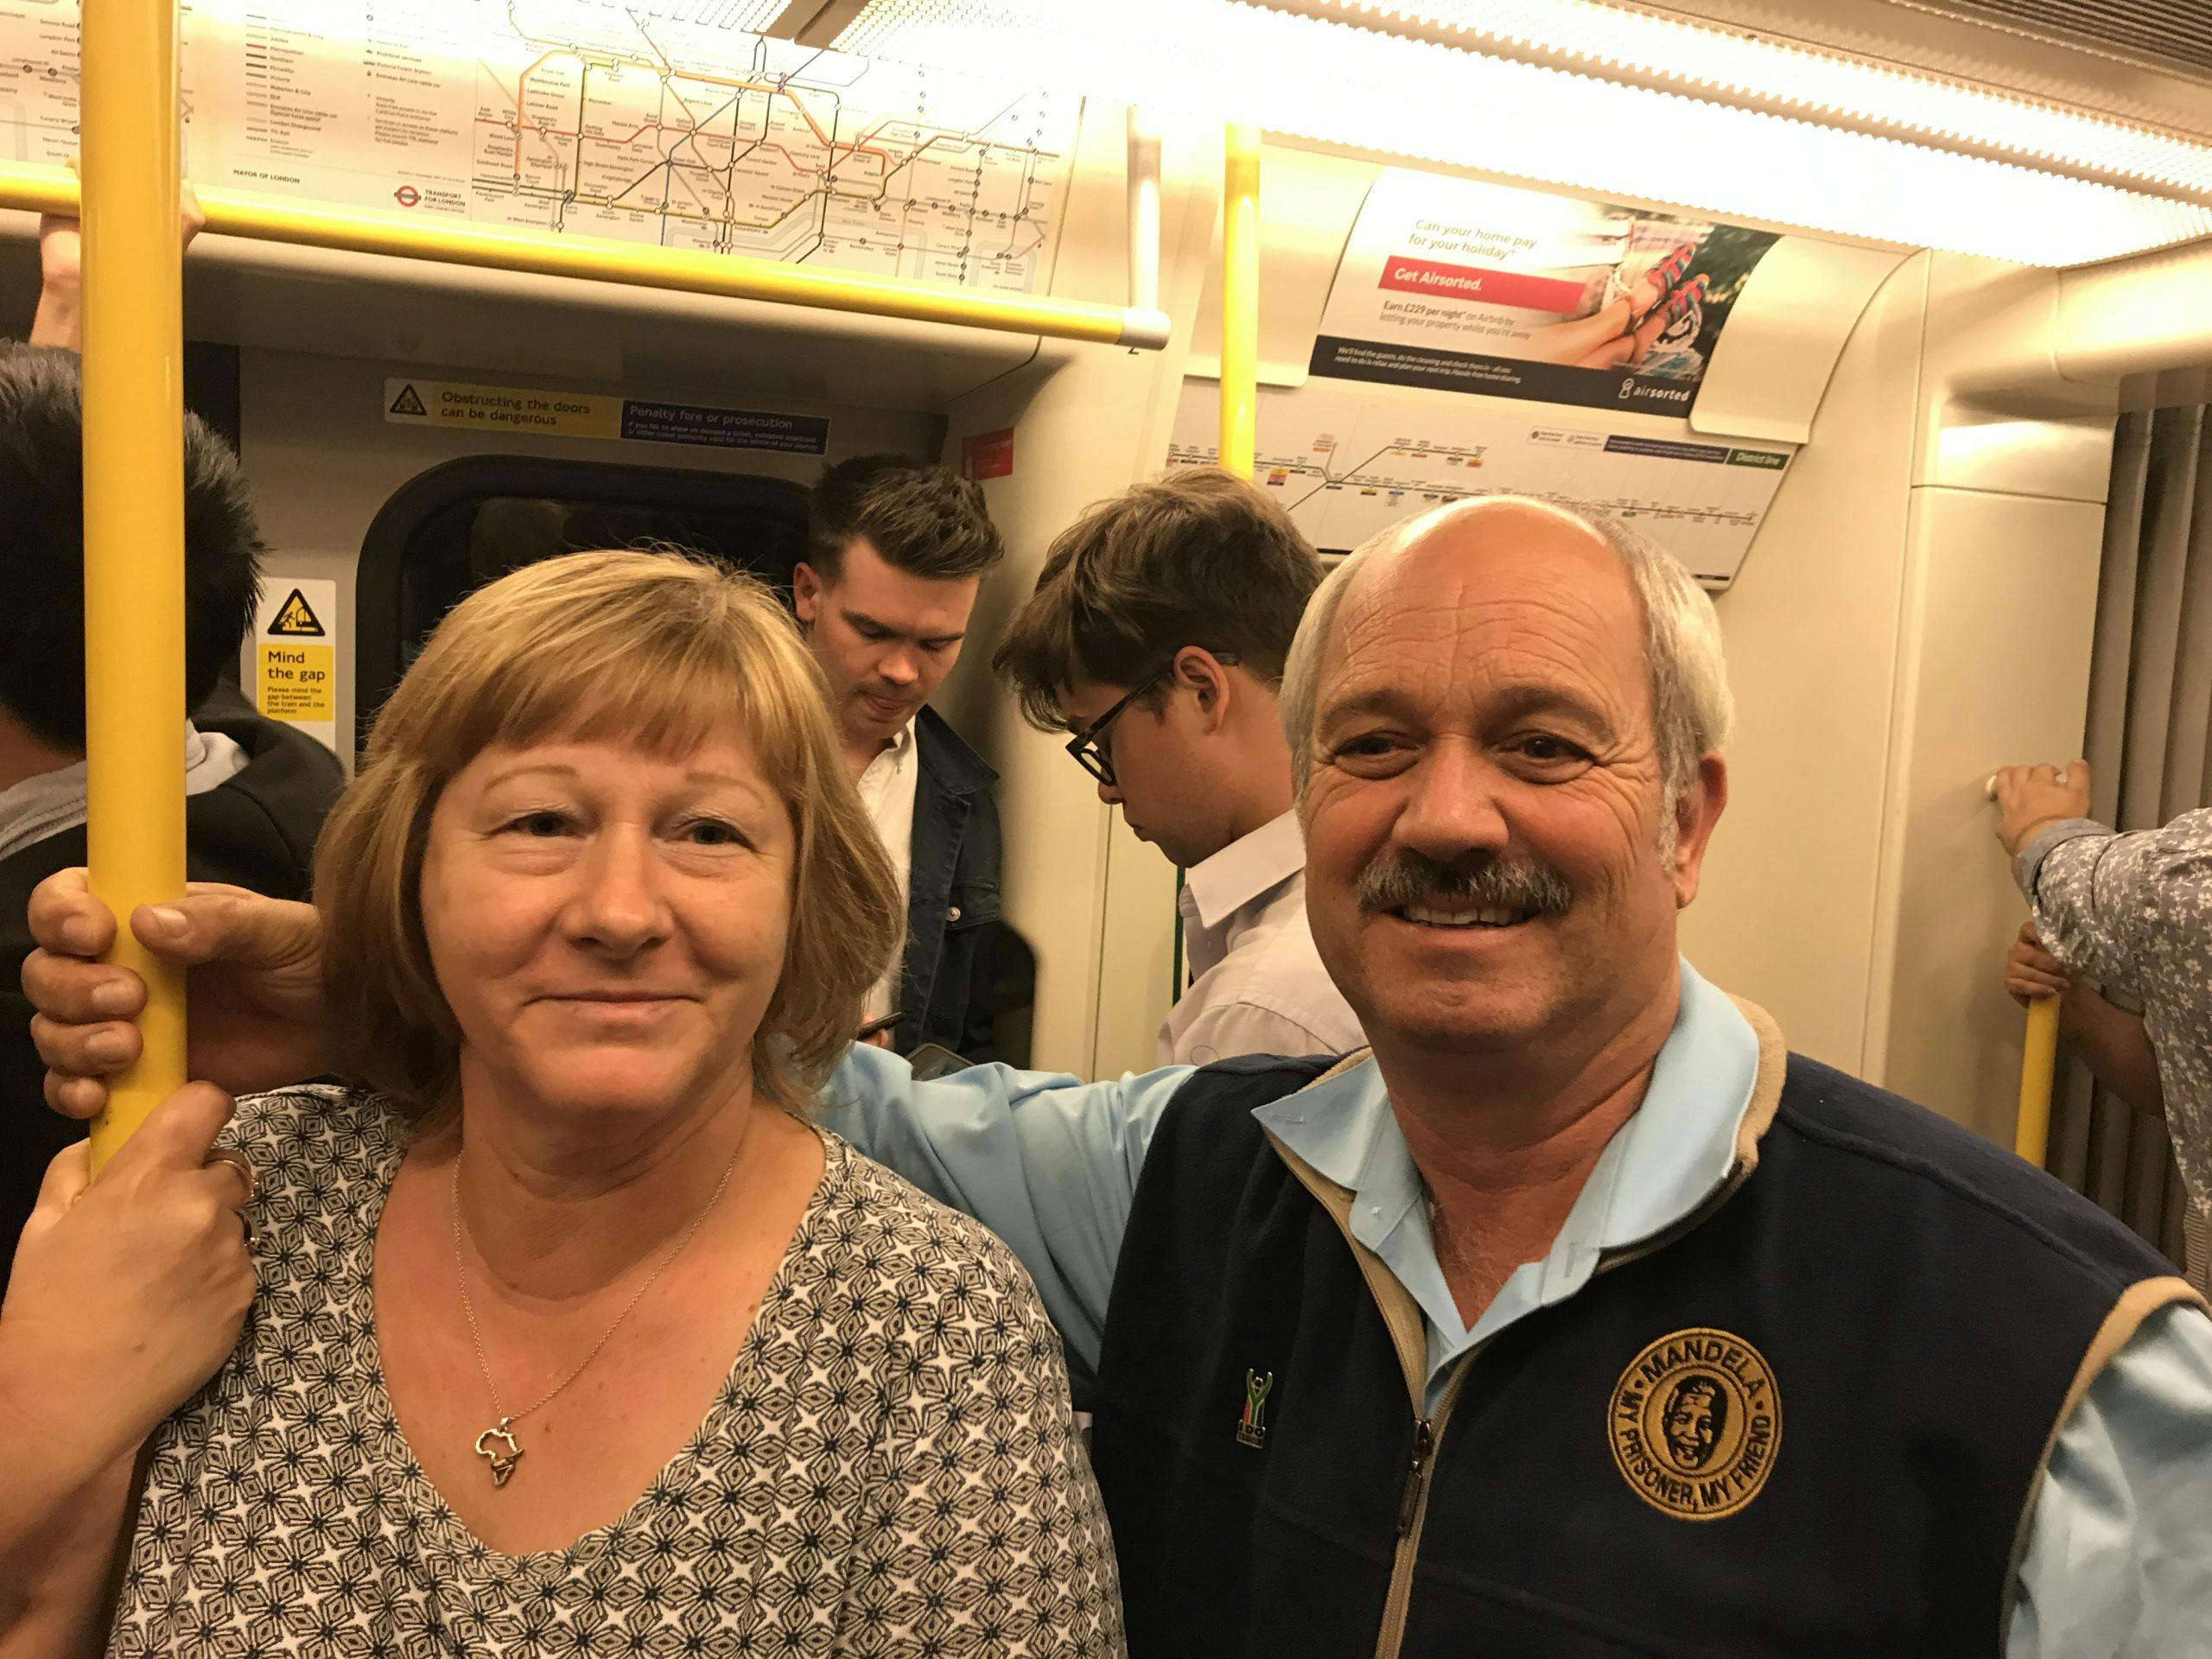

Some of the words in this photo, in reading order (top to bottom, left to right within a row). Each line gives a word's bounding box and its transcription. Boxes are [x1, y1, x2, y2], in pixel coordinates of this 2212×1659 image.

[232, 168, 257, 179] MAYOR
[270, 174, 300, 184] LONDON
[425, 189, 461, 200] TRANSPORT
[437, 198, 466, 207] LONDON
[1408, 233, 1427, 246] for
[1428, 238, 1458, 251] your
[1462, 241, 1516, 260] holiday?
[1415, 219, 1442, 233] Can
[1443, 225, 1471, 237] your
[1476, 228, 1511, 243] home
[1512, 237, 1538, 250] pay
[1395, 267, 1418, 282] Get
[1420, 270, 1483, 292] Airsorted.
[1383, 300, 1402, 312] Earn
[1403, 302, 1426, 315] £229
[1427, 307, 1440, 318] per
[1478, 312, 1505, 326] Airbnb
[1506, 317, 1516, 327] by
[1379, 311, 1407, 326] letting
[1408, 317, 1425, 327] your
[1427, 318, 1461, 332] property
[1462, 321, 1485, 333] whilst
[1511, 330, 1532, 341] away
[442, 391, 522, 410] Obstructing
[527, 397, 549, 410] the
[553, 400, 590, 415] doors
[1633, 384, 1691, 403] airsorted
[441, 407, 464, 418] can
[468, 407, 485, 419] be
[490, 408, 557, 426] dangerous
[630, 404, 675, 422] Penalty
[679, 409, 703, 423] fare
[707, 414, 719, 423] or
[722, 415, 793, 429] prosecution
[267, 651, 305, 664] Mind
[267, 667, 294, 680] the
[300, 670, 326, 683] gap
[1639, 1339, 1765, 1401] MANDELA
[1618, 1390, 1643, 1424] MY
[1699, 1475, 1732, 1507] MY
[1728, 1415, 1771, 1491] FRIEND
